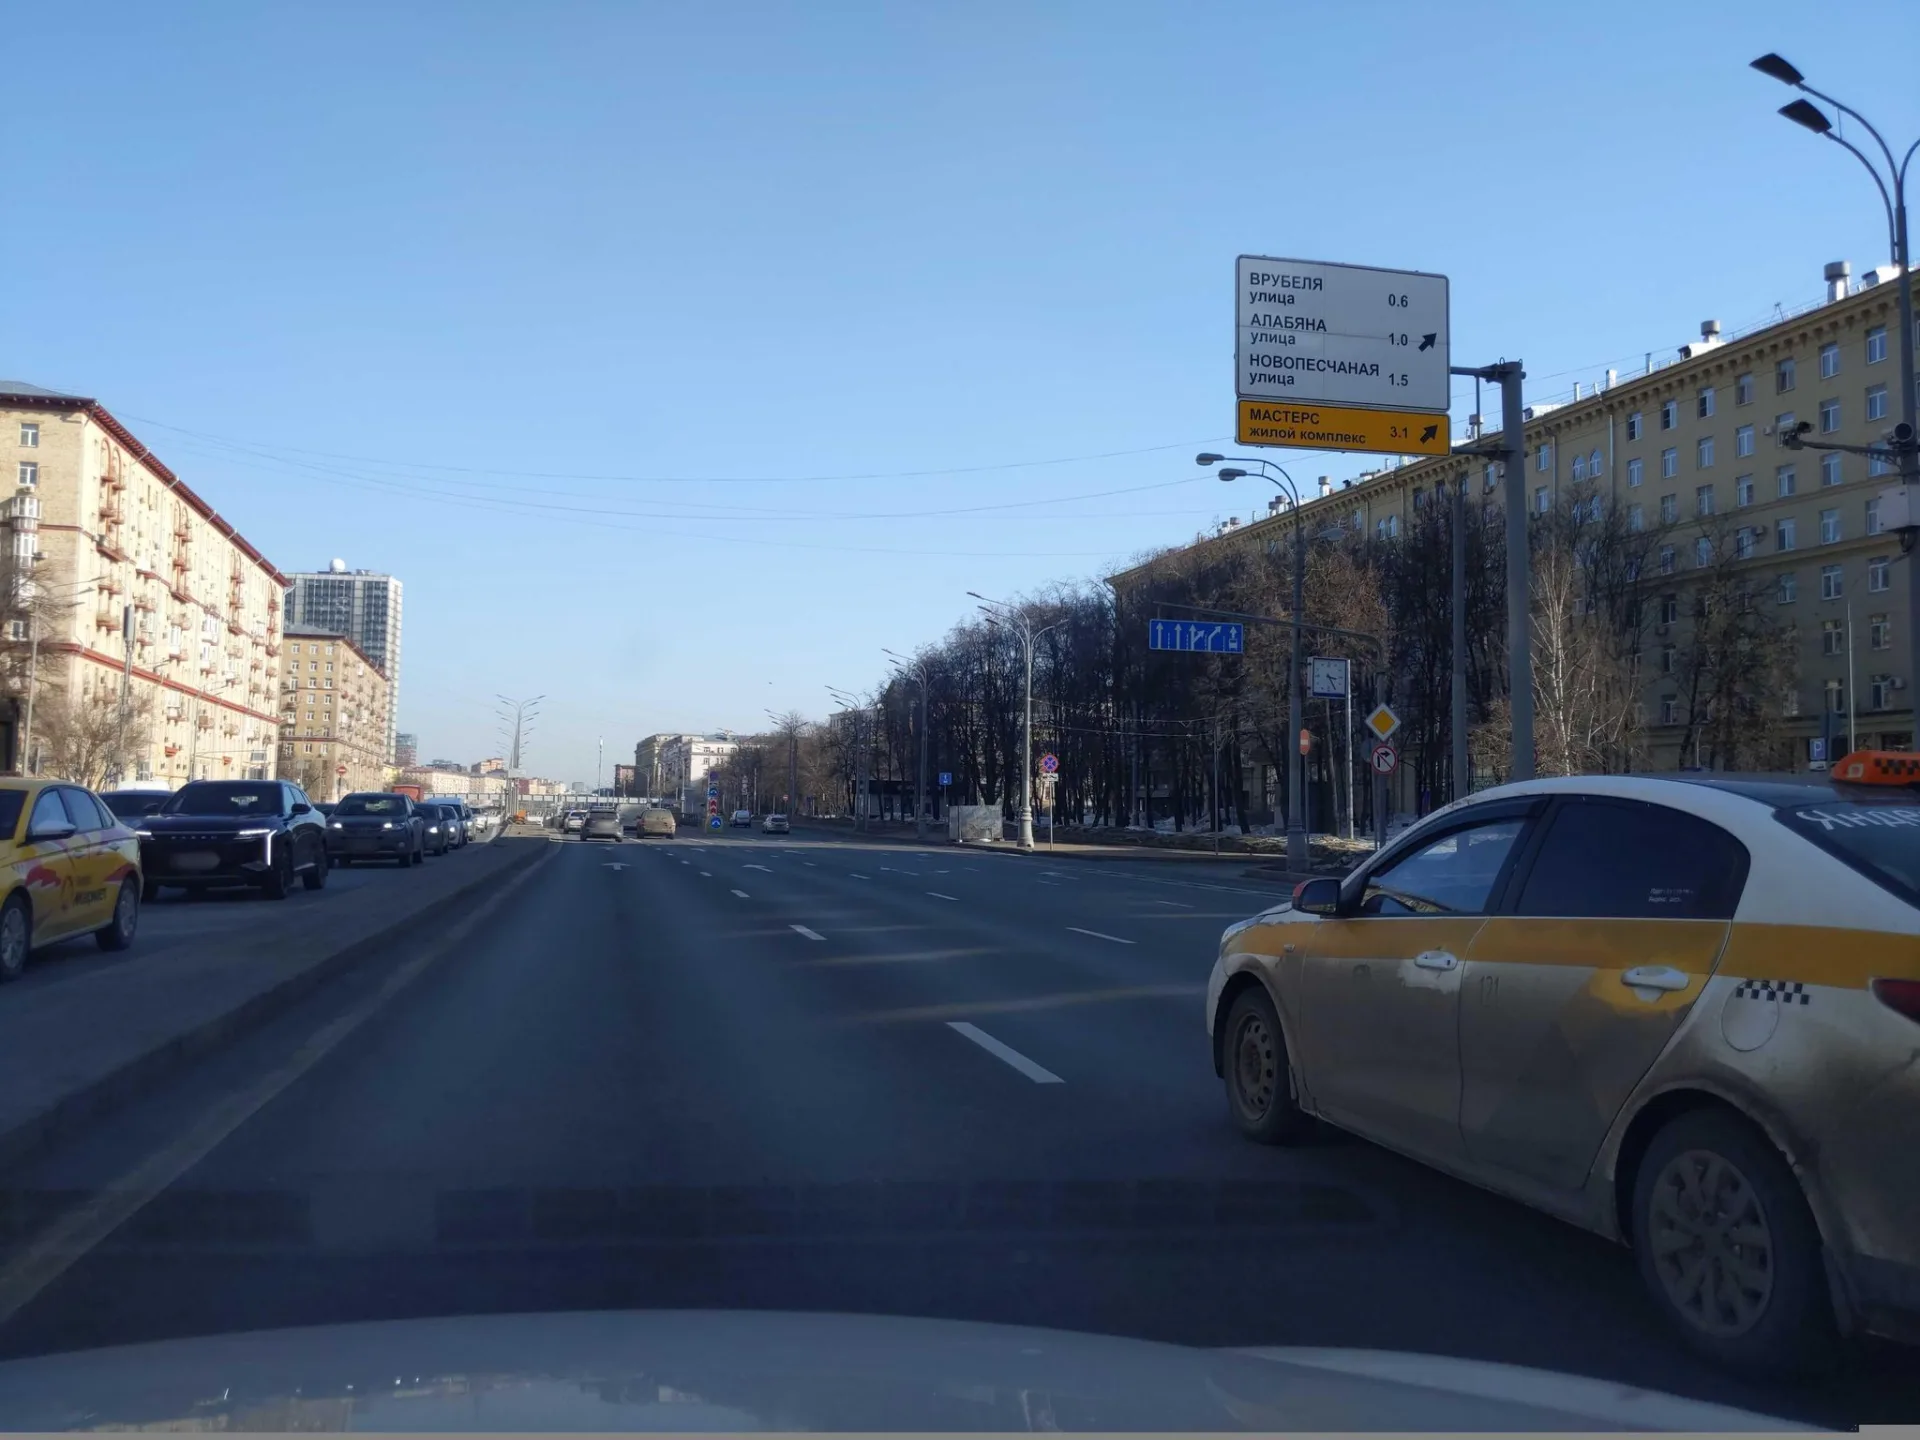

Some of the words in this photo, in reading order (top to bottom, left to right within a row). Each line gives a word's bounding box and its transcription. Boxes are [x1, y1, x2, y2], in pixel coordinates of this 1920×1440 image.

[1249, 272, 1323, 292] ВРУБЕЛЯ
[1249, 290, 1295, 305] улица
[1388, 293, 1409, 308] 0.6
[1250, 313, 1327, 332] АЛАБЯНА
[1250, 331, 1296, 346] улица
[1388, 333, 1409, 346] 1.0
[1249, 353, 1380, 377] НОВОПЕСЧАНАЯ
[1249, 371, 1295, 386] улица
[1388, 373, 1409, 387] 1.5
[1249, 408, 1320, 425] МАСТЕРС
[1249, 426, 1296, 440] жилой
[1300, 429, 1367, 444] комплекс
[1389, 425, 1409, 438] 3.1
